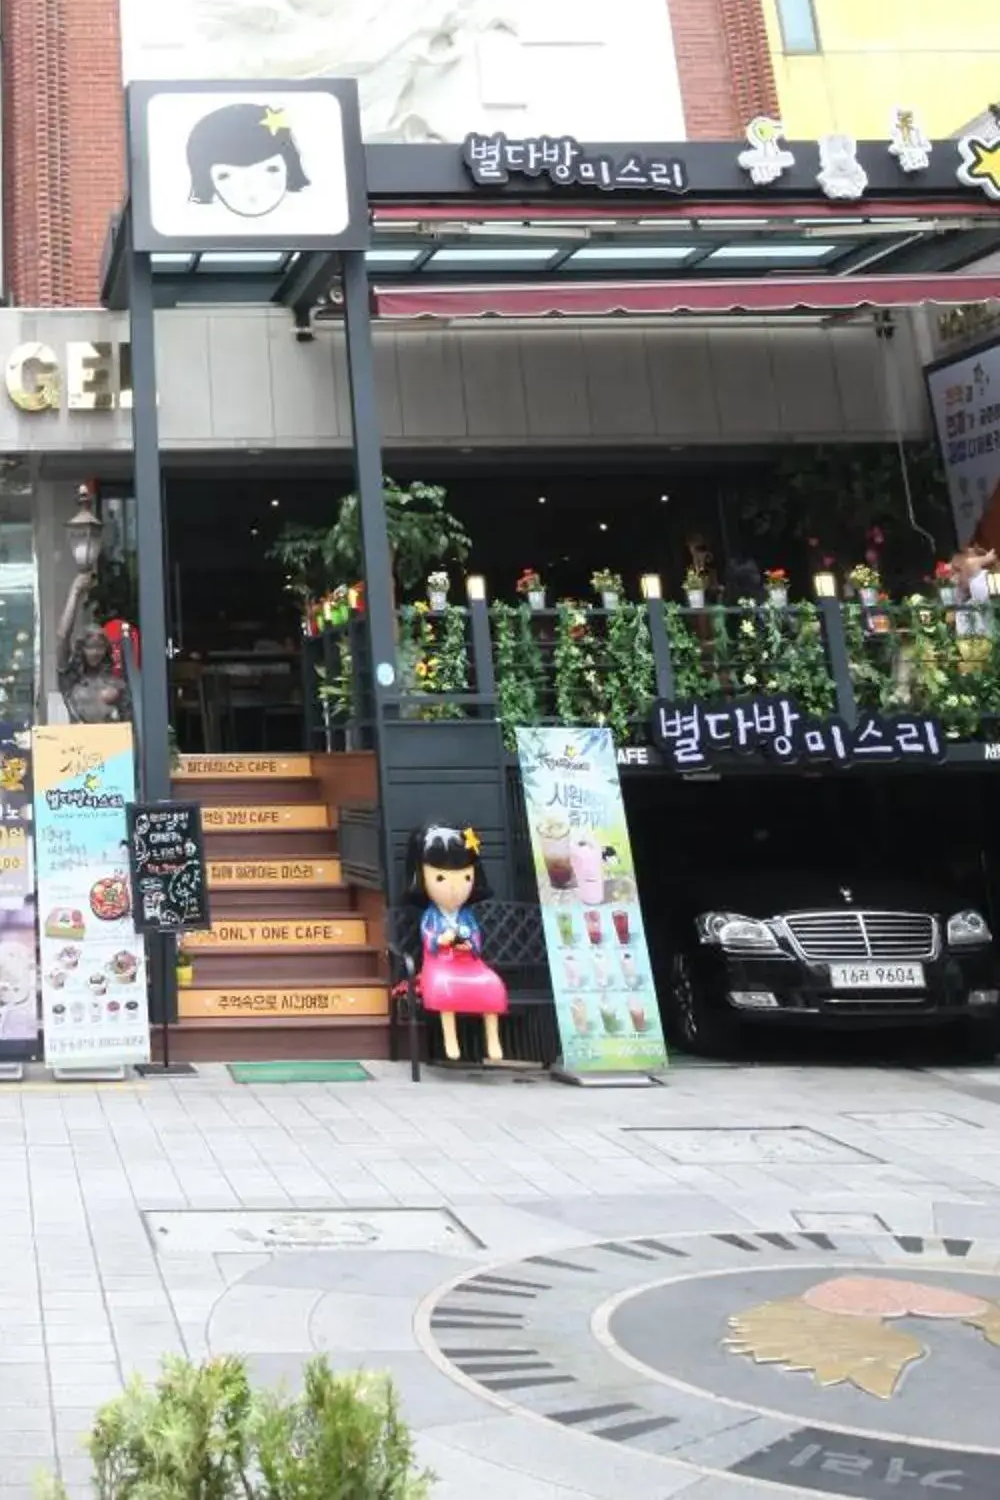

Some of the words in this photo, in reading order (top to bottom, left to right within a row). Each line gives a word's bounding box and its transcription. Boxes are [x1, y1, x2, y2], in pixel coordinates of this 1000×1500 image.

[468, 137, 685, 189] 별다방미스리
[659, 700, 941, 764] 별다방미스리
[617, 747, 649, 765] AFE
[247, 760, 278, 773] CAFE
[249, 811, 280, 824] CAFE
[219, 926, 256, 941] ONLY
[261, 926, 289, 941] ONE
[295, 925, 333, 940] CAFE
[874, 965, 917, 984] 9604
[217, 994, 278, 1011] 추억속으로
